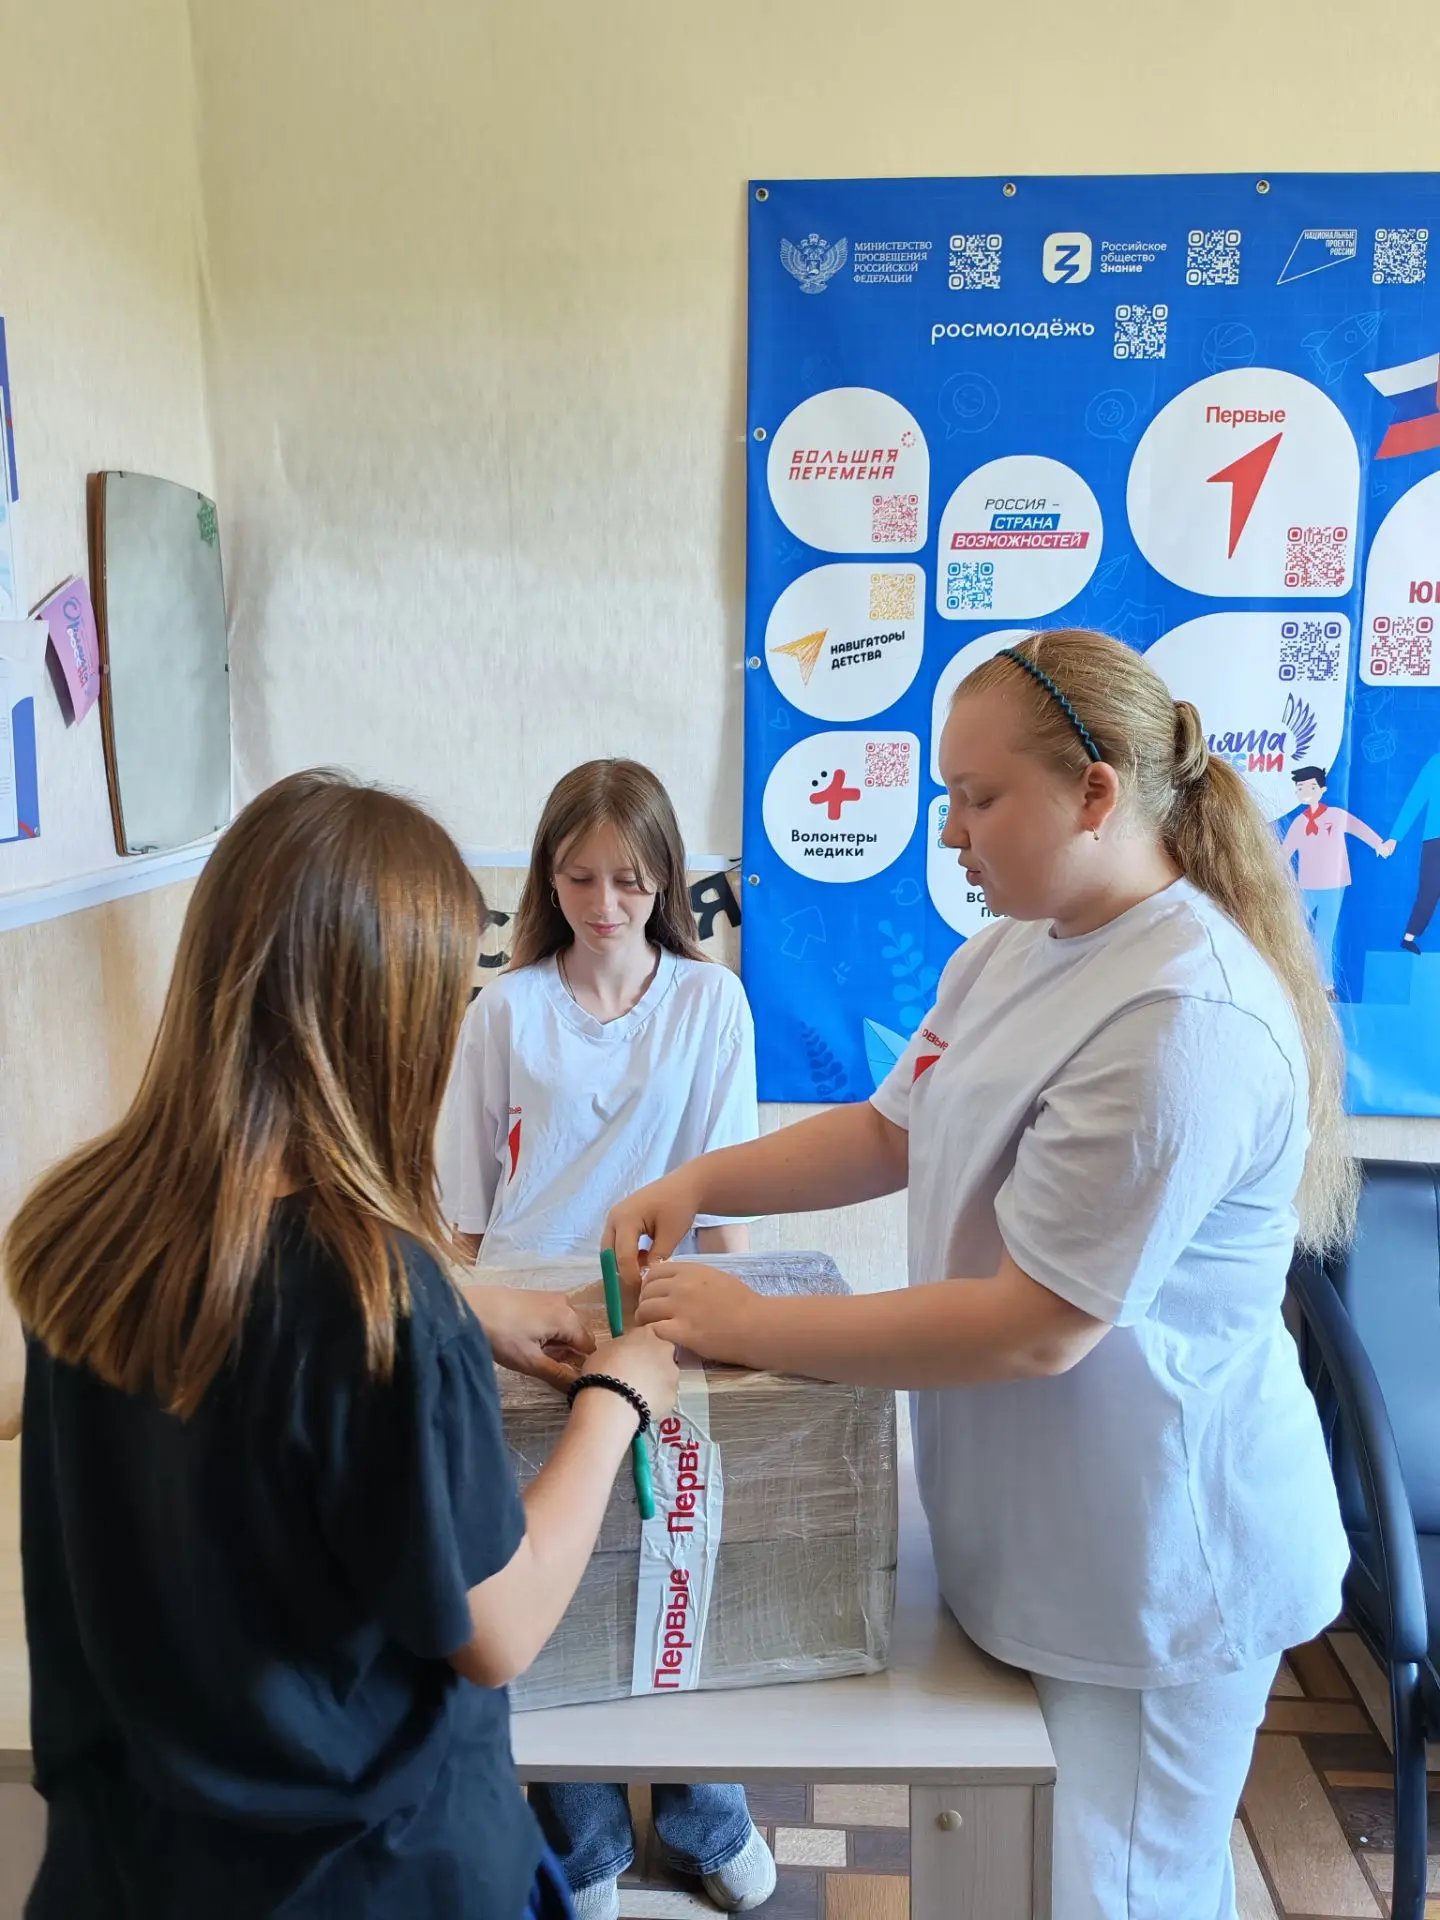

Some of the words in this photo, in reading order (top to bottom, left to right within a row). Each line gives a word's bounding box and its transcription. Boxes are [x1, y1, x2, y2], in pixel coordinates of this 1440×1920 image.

[1304, 231, 1355, 240] НАЦИОНАЛЬНЫЕ
[854, 241, 933, 251] МИНИСТЕРСТВО
[1101, 241, 1168, 251] Российское
[1326, 240, 1355, 248] ПРОЕКТЫ
[854, 252, 928, 262] ПРОСВЕЩЕНИЯ
[1100, 252, 1155, 263] общество
[1330, 248, 1354, 256] РОССИИ
[853, 262, 919, 273] РОССИЙСКОЙ
[1100, 263, 1143, 273] Знание
[853, 274, 913, 284] ФЕДЕРАЦИИ
[931, 318, 1095, 345] росмолодёжь
[1206, 406, 1286, 428] Первые
[792, 449, 899, 464] БОЛЬШАЯ
[789, 466, 895, 480] ПЕРЕМЕНА
[985, 499, 1047, 510] РОССИЯ
[994, 517, 1053, 529] СТРАНА
[955, 533, 1082, 547] ВОЗМОЖНОСТЕЙ
[1409, 581, 1440, 603] Ю
[830, 630, 905, 655] НАВИГАТОРЫ
[831, 649, 882, 670] ДЕТСТВА
[791, 829, 877, 846] Волонтеры
[804, 847, 864, 858] медики
[654, 1568, 692, 1689] Первые
